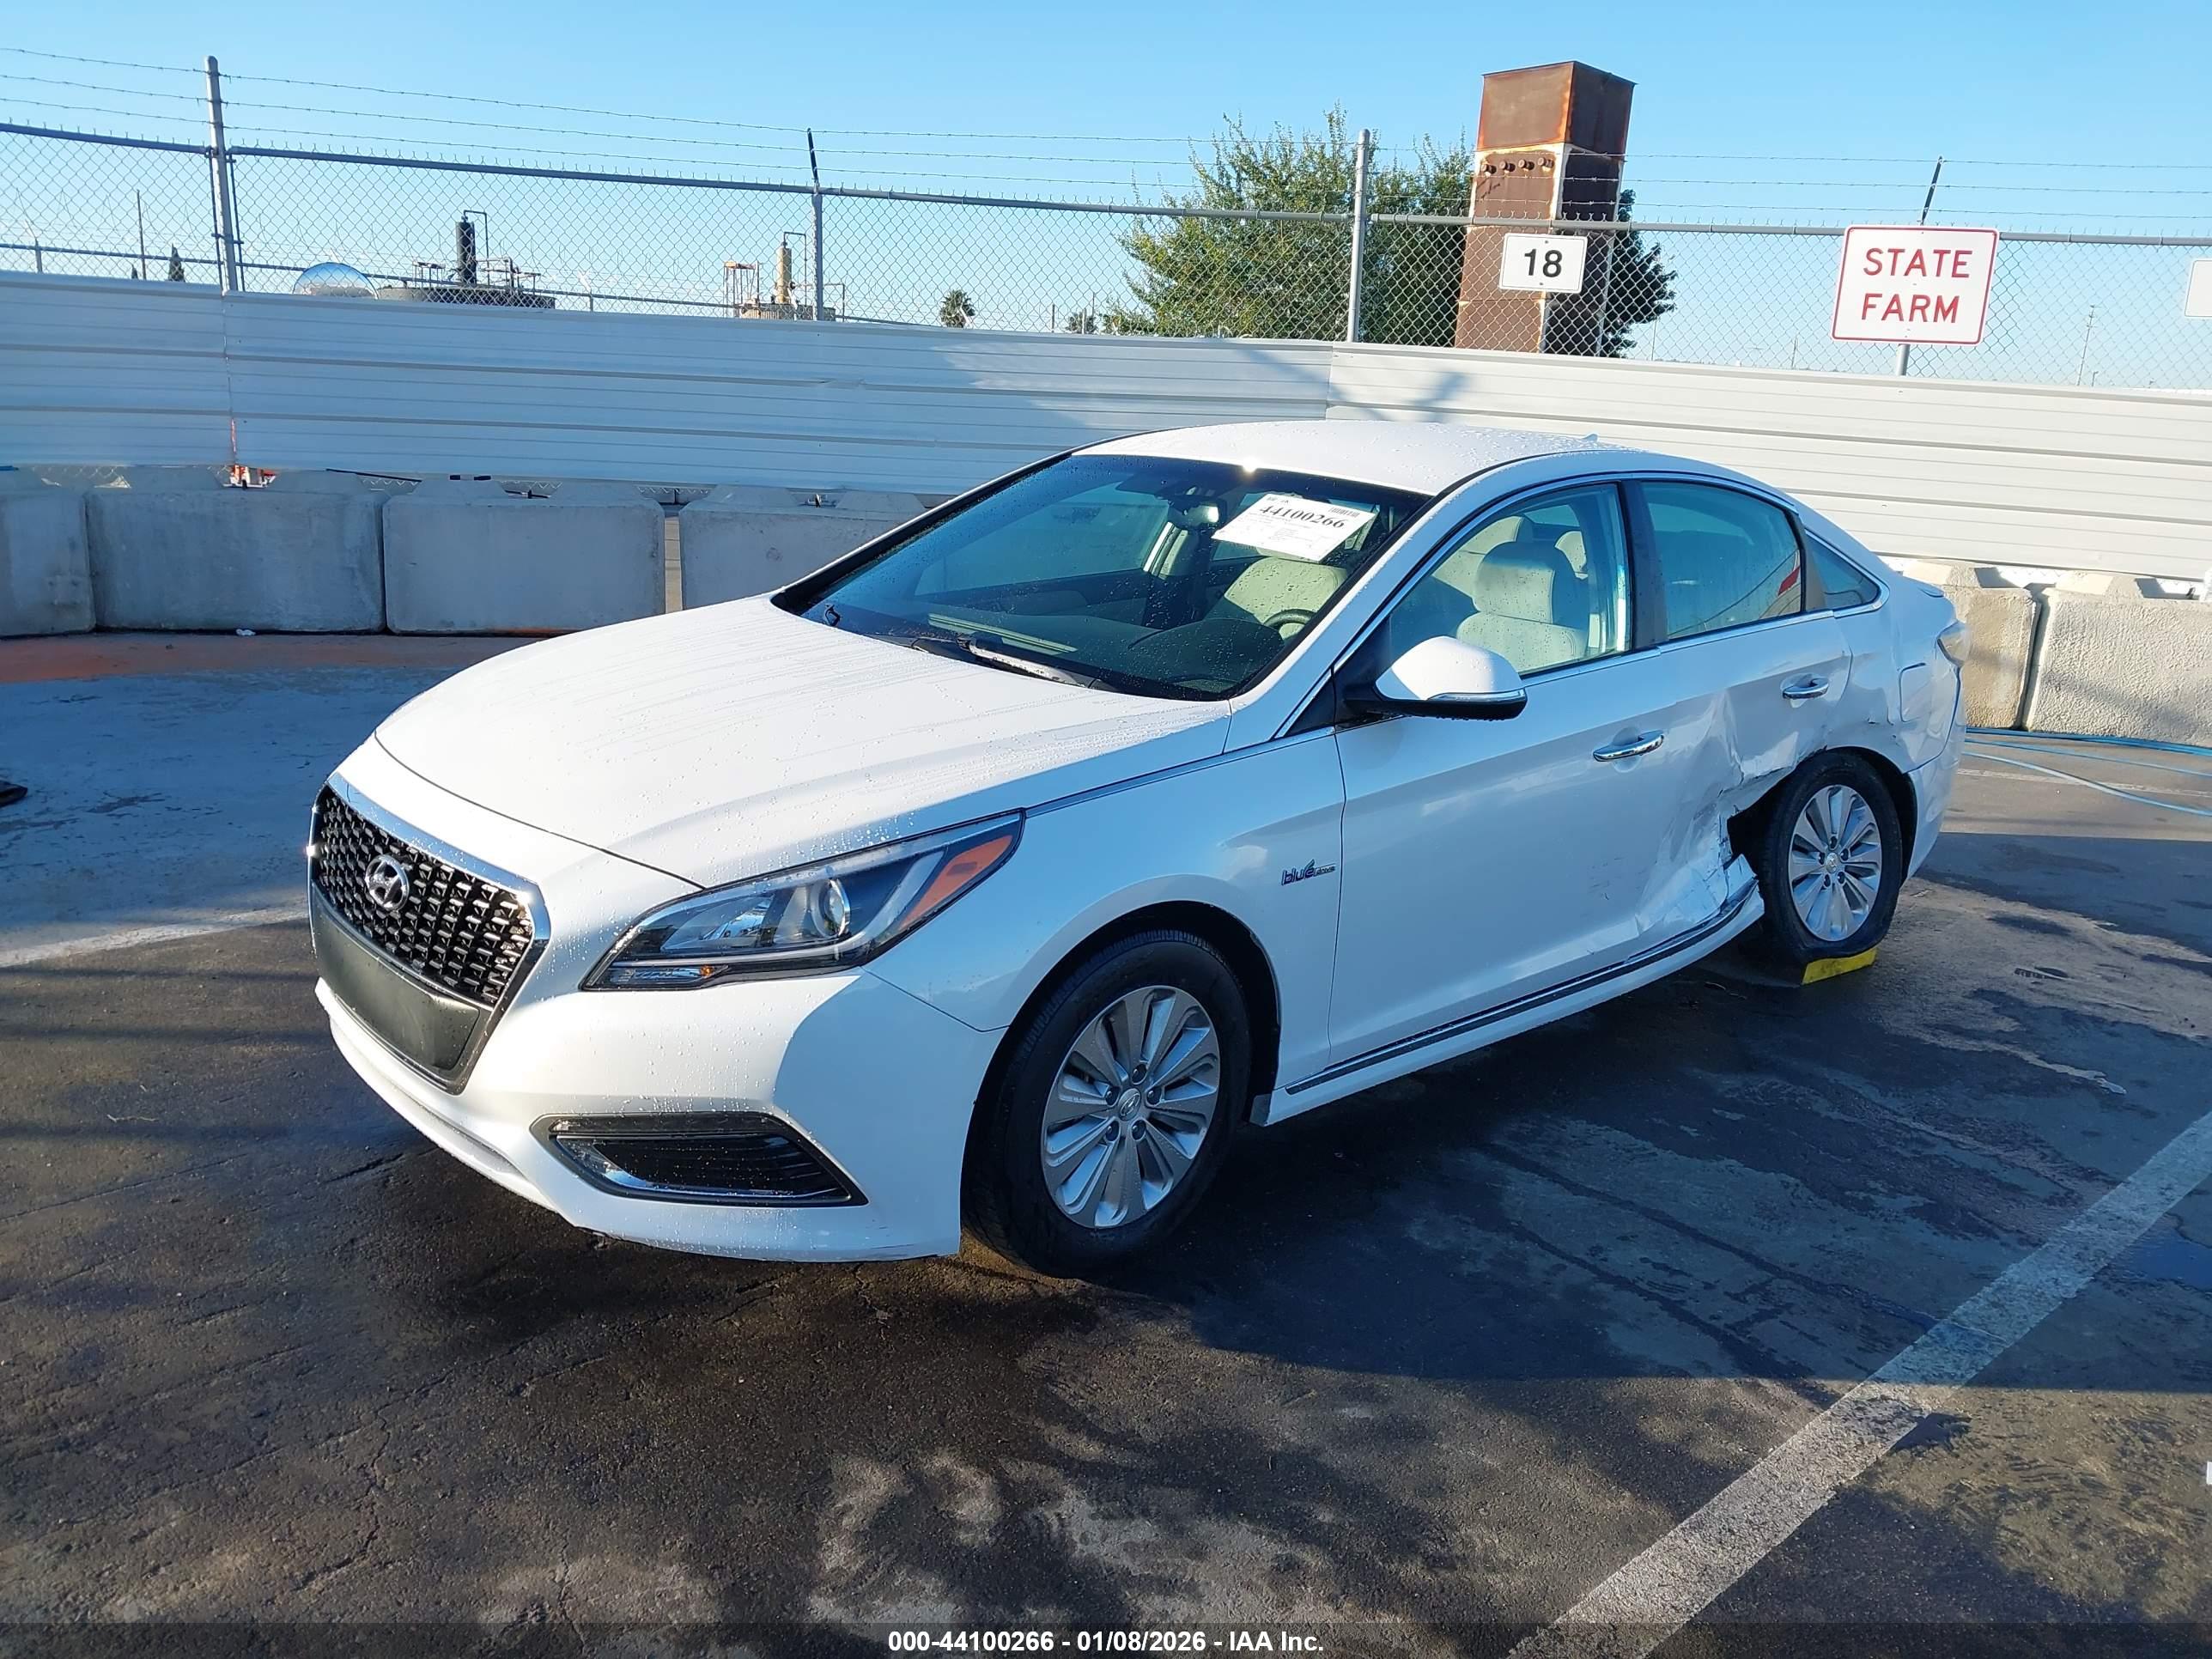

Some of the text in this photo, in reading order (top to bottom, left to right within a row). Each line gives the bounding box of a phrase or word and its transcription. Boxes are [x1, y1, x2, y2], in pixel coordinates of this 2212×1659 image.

[1523, 248, 1563, 278] 18
[1863, 247, 1973, 278] STATE
[1861, 293, 1960, 324] FARM
[1260, 505, 1347, 528] 44100266
